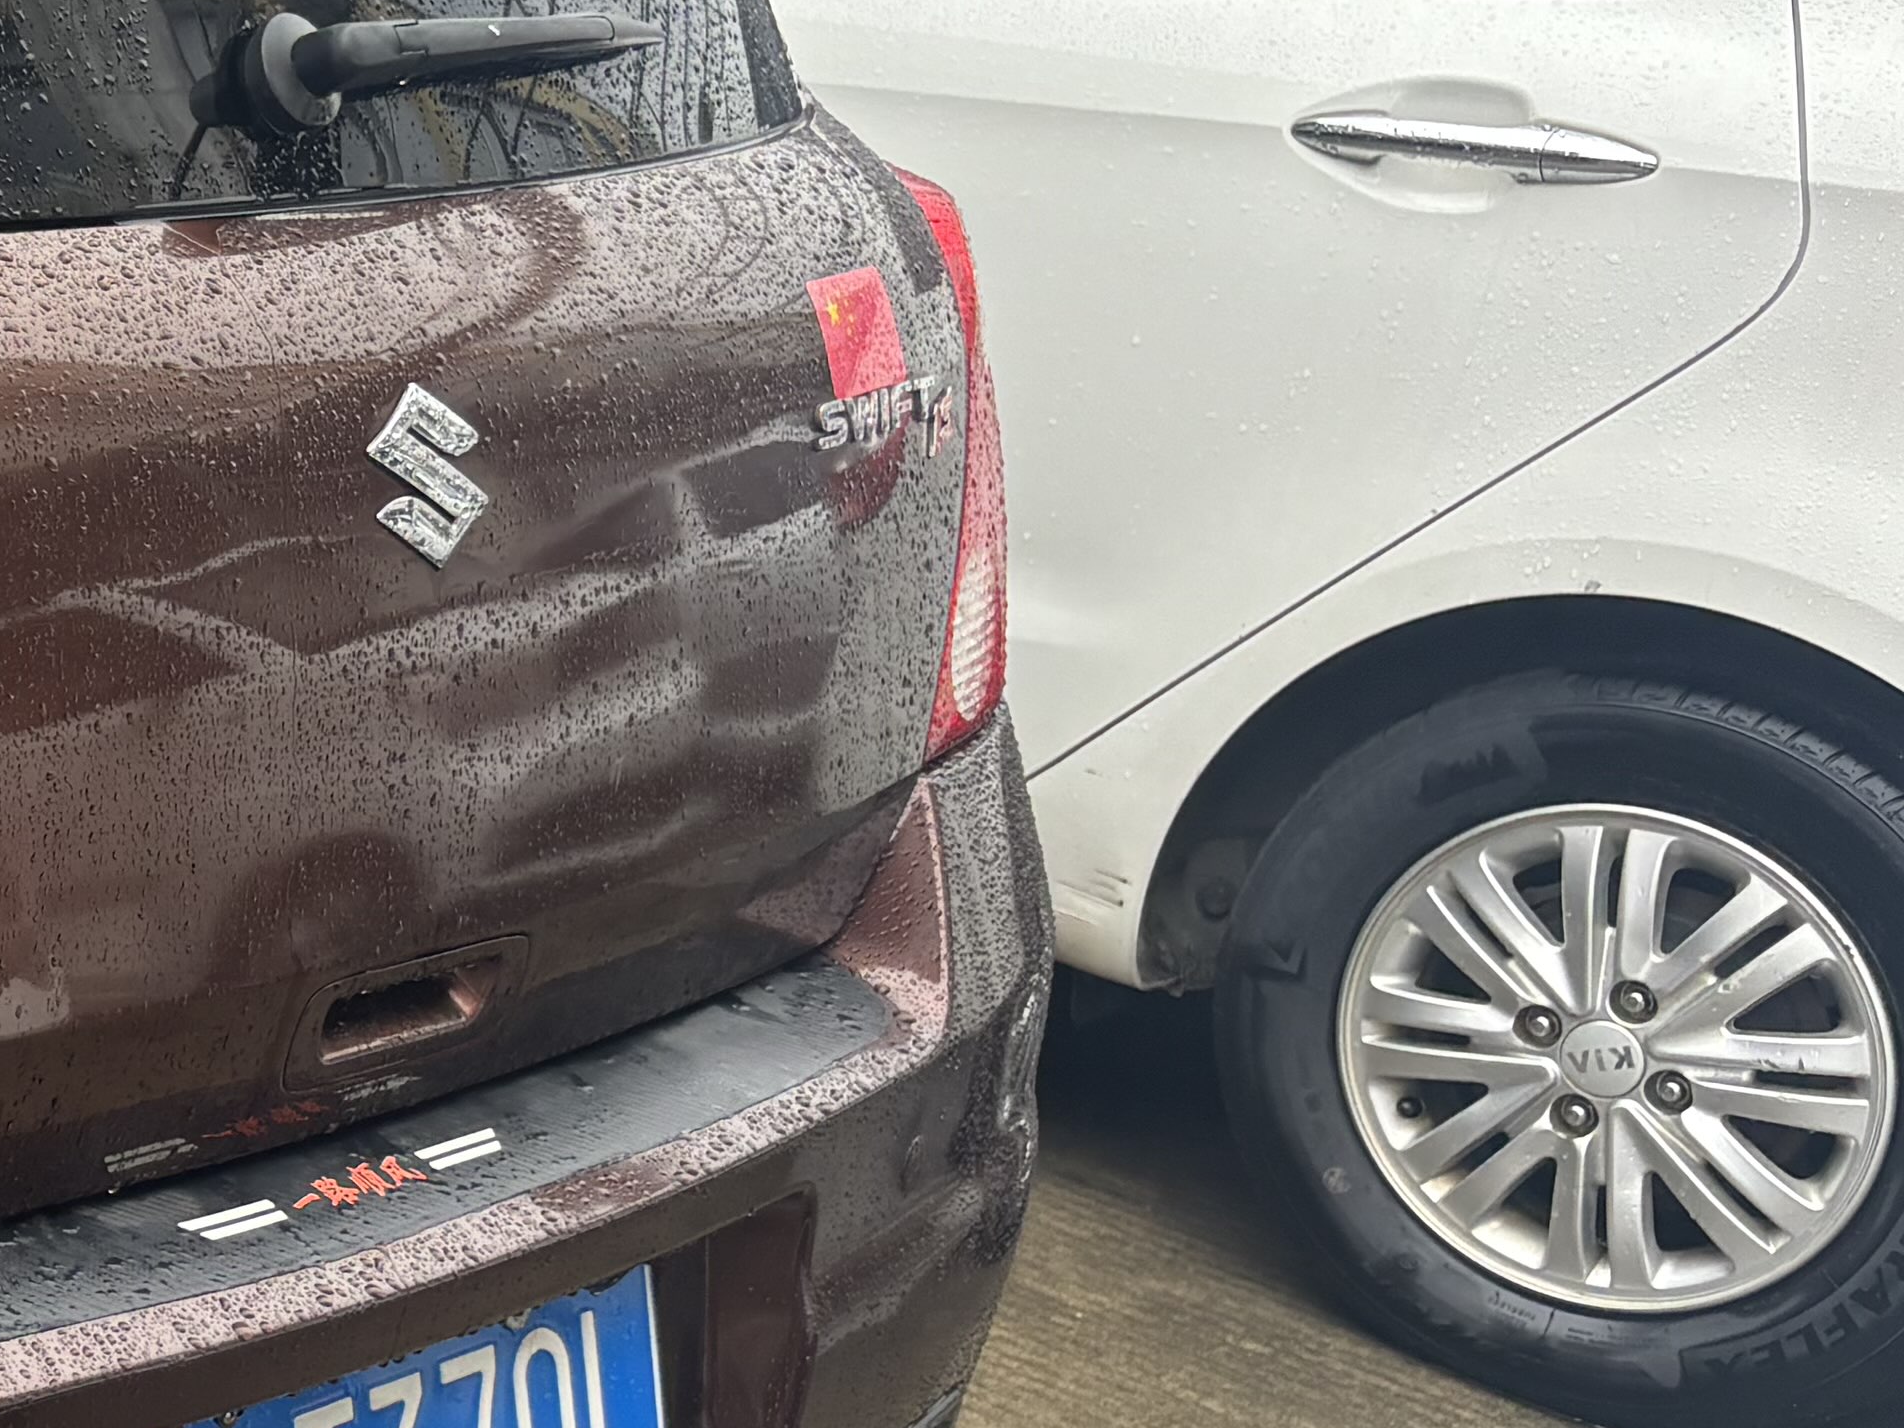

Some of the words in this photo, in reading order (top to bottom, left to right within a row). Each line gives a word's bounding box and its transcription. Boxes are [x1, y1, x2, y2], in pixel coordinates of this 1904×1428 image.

[817, 376, 935, 451] SWIFT
[1566, 1045, 1635, 1074] KIA
[291, 1155, 429, 1209] 一路顺风
